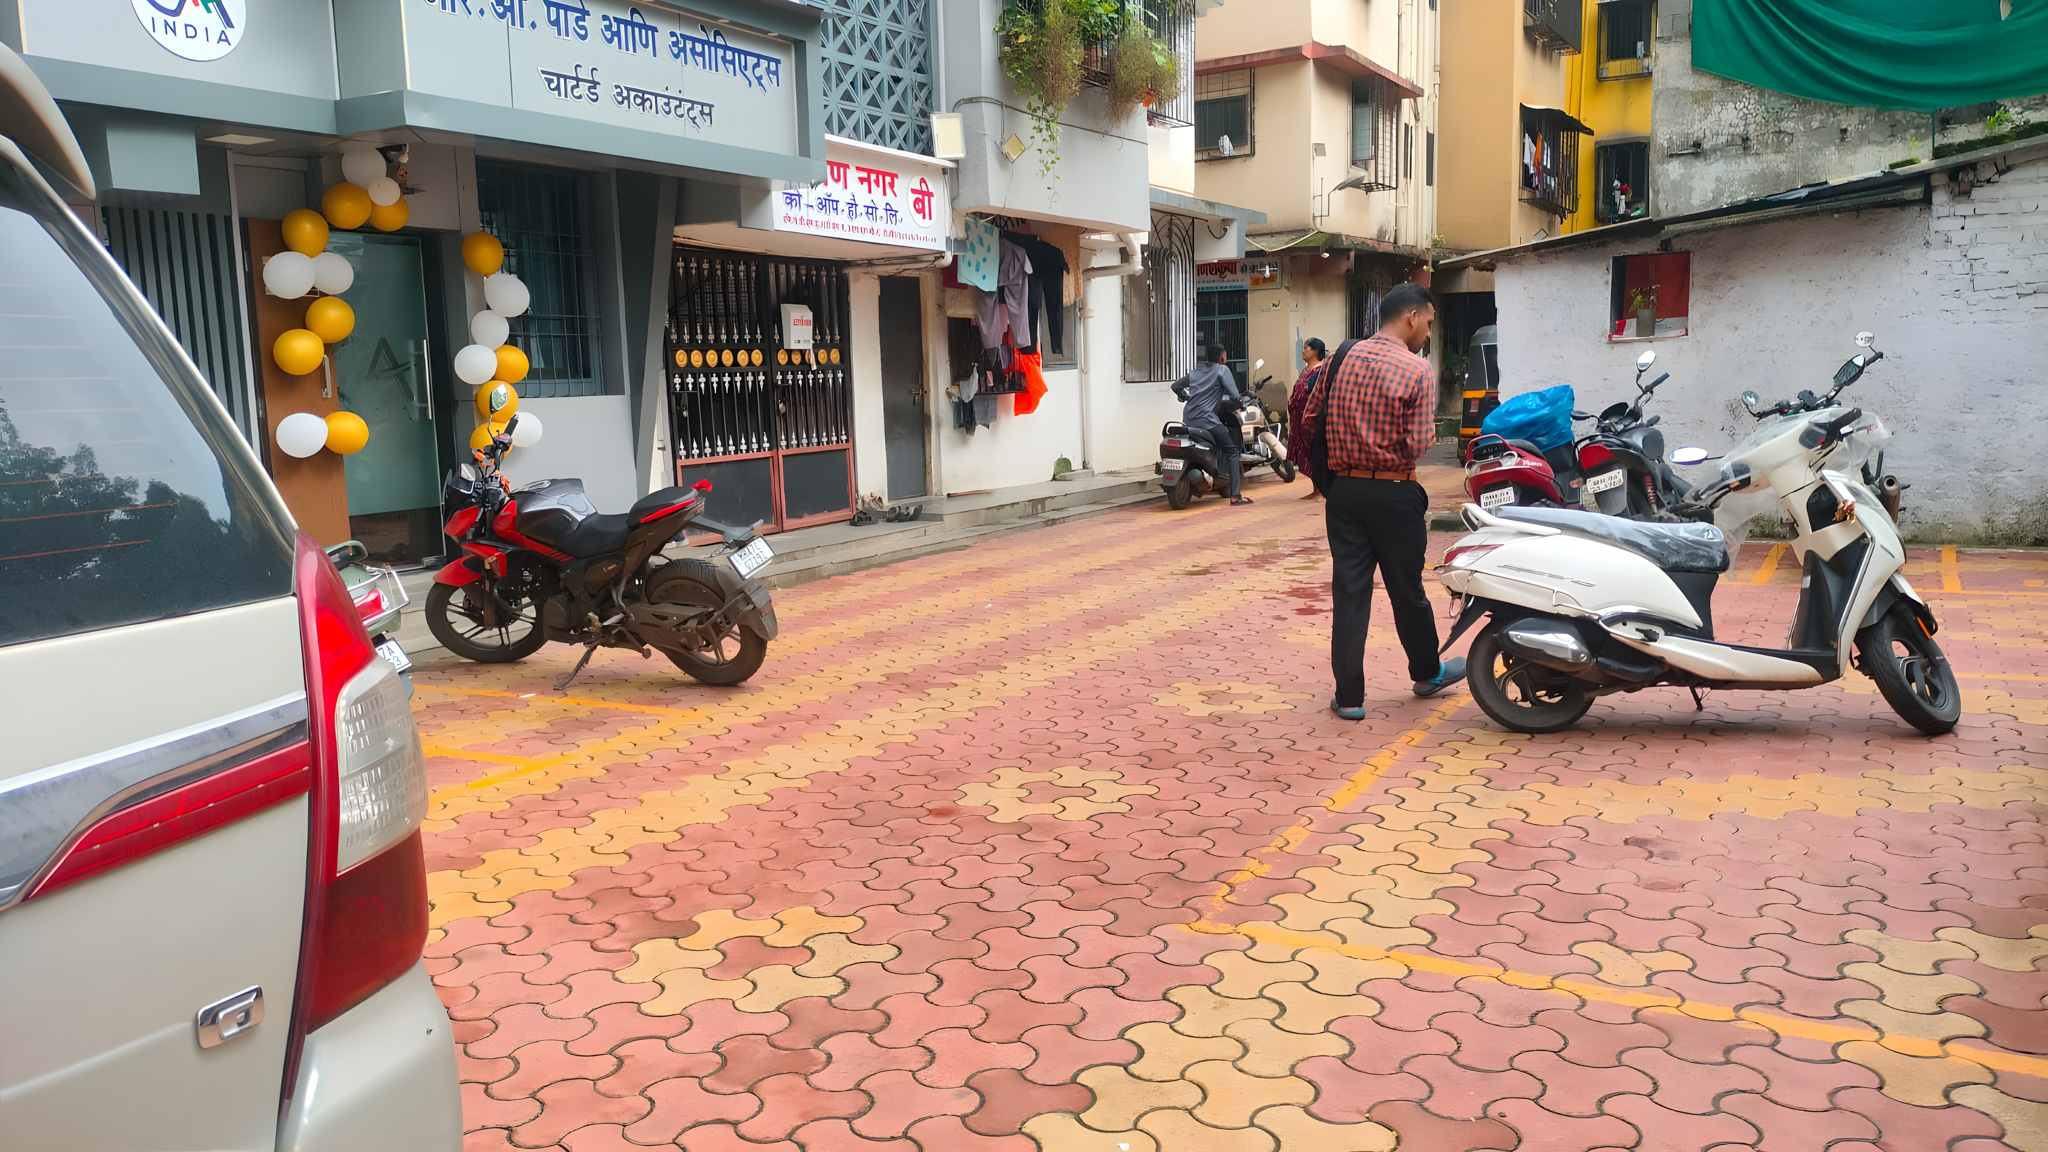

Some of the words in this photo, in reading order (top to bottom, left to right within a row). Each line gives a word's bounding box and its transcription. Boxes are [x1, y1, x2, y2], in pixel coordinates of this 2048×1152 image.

[151, 15, 231, 46] INDIA
[600, 7, 659, 58] आणि
[668, 23, 782, 93] असोसिएट्स
[540, 63, 601, 103] चार्टर्ड
[613, 84, 715, 130] अकाउंटंट्स
[855, 165, 898, 198] नगर
[910, 177, 934, 220] बी
